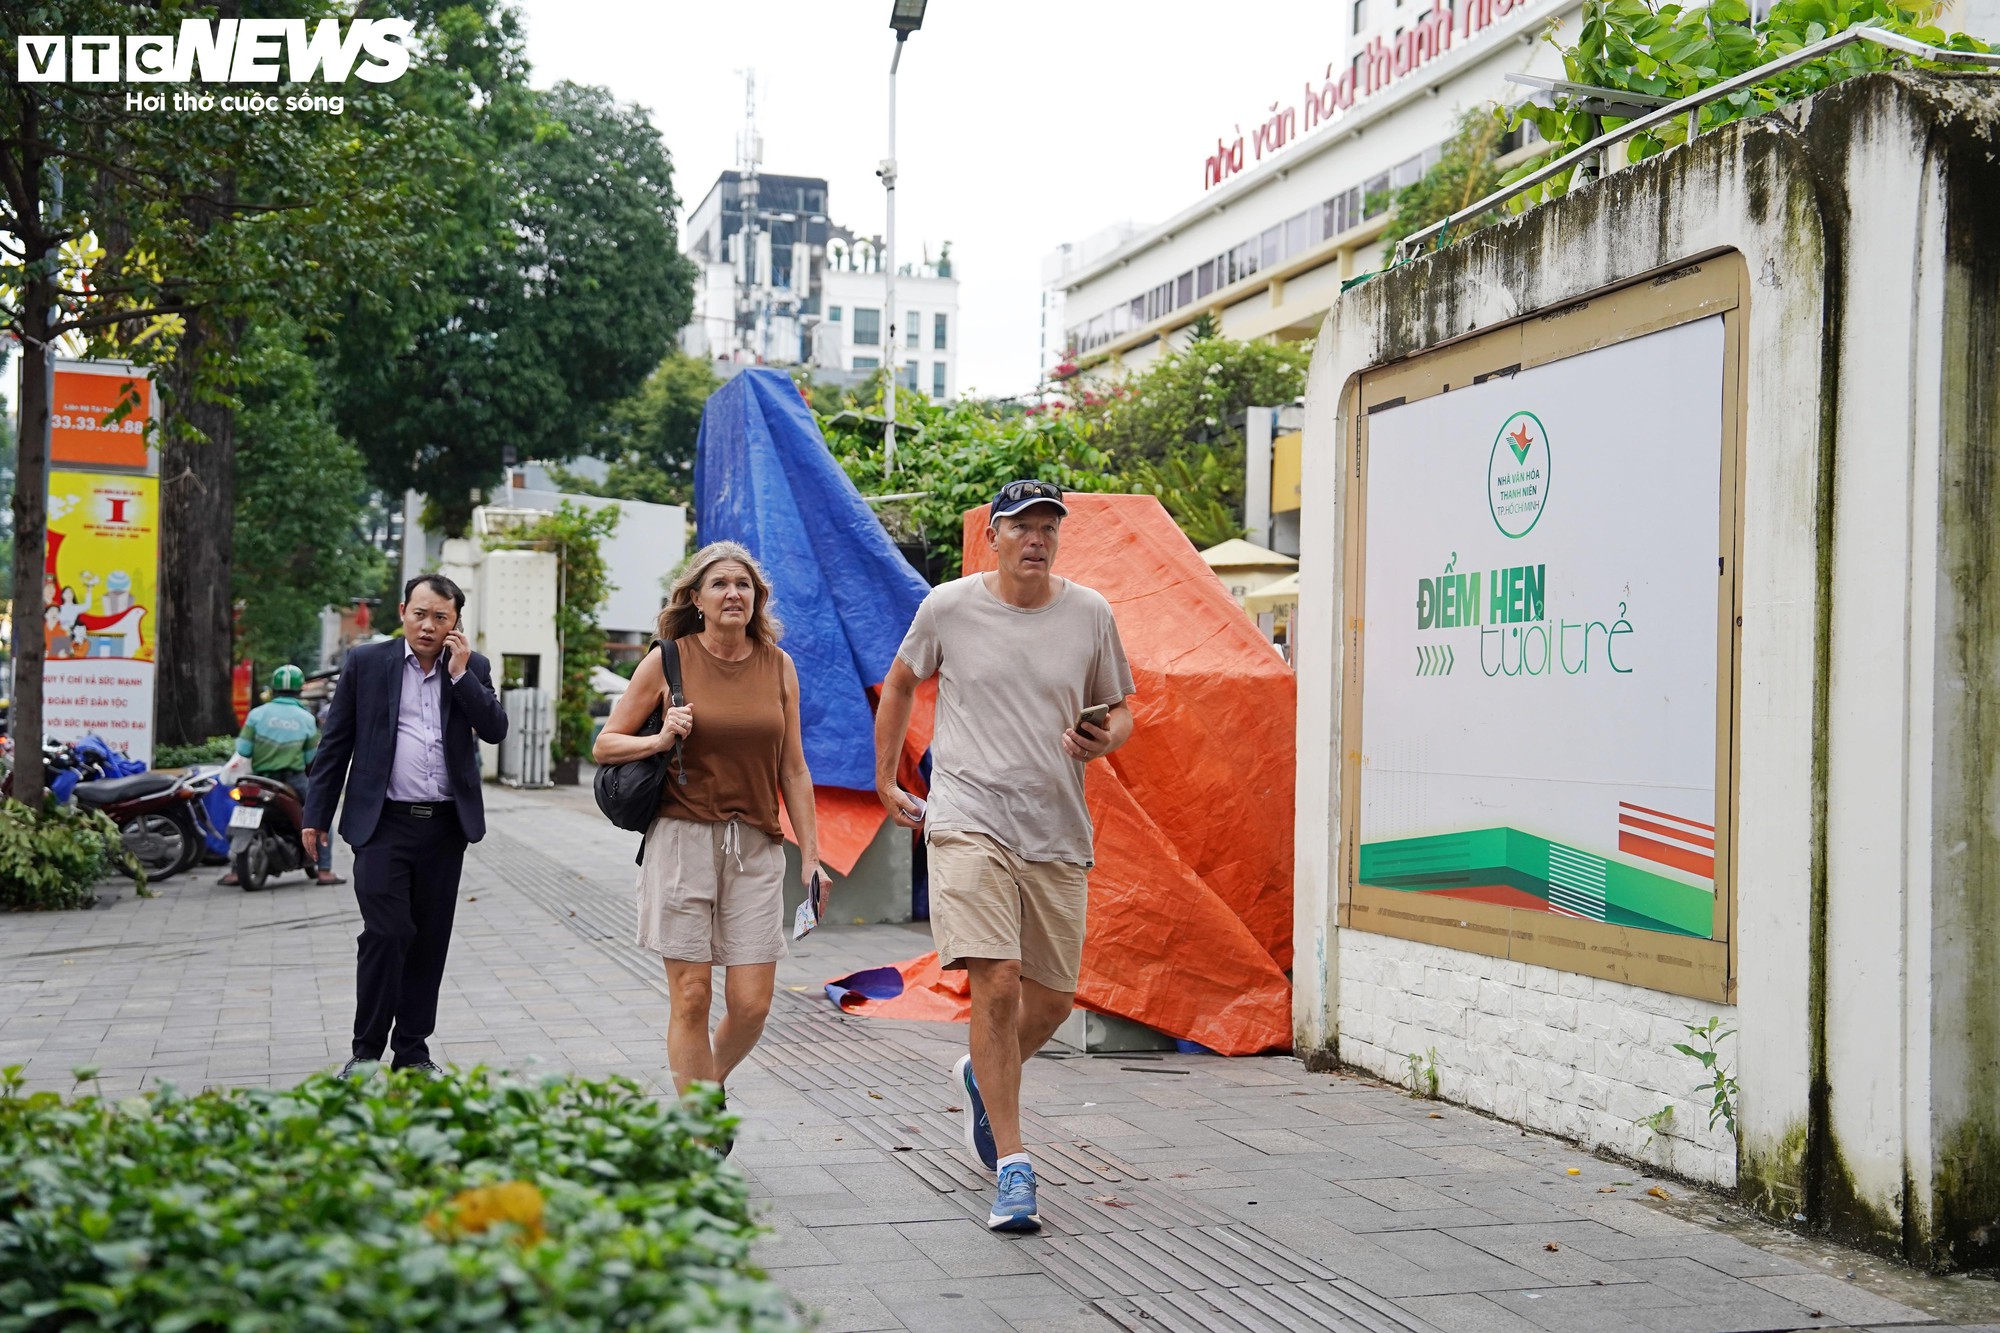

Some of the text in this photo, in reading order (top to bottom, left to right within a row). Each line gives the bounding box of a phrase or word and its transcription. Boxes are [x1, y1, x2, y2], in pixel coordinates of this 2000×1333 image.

[1205, 124, 1244, 190] nhà
[1252, 101, 1296, 161] văn
[1305, 62, 1356, 131] hóa
[1364, 0, 1452, 95] thanh
[1497, 468, 1540, 486] NHÀ VĂN HÓA
[1500, 484, 1537, 500] THANH NIÊN
[1416, 551, 1481, 630] ĐIỂM
[1480, 600, 1634, 677] tuổi trẻ
[118, 676, 142, 687] MẠNH
